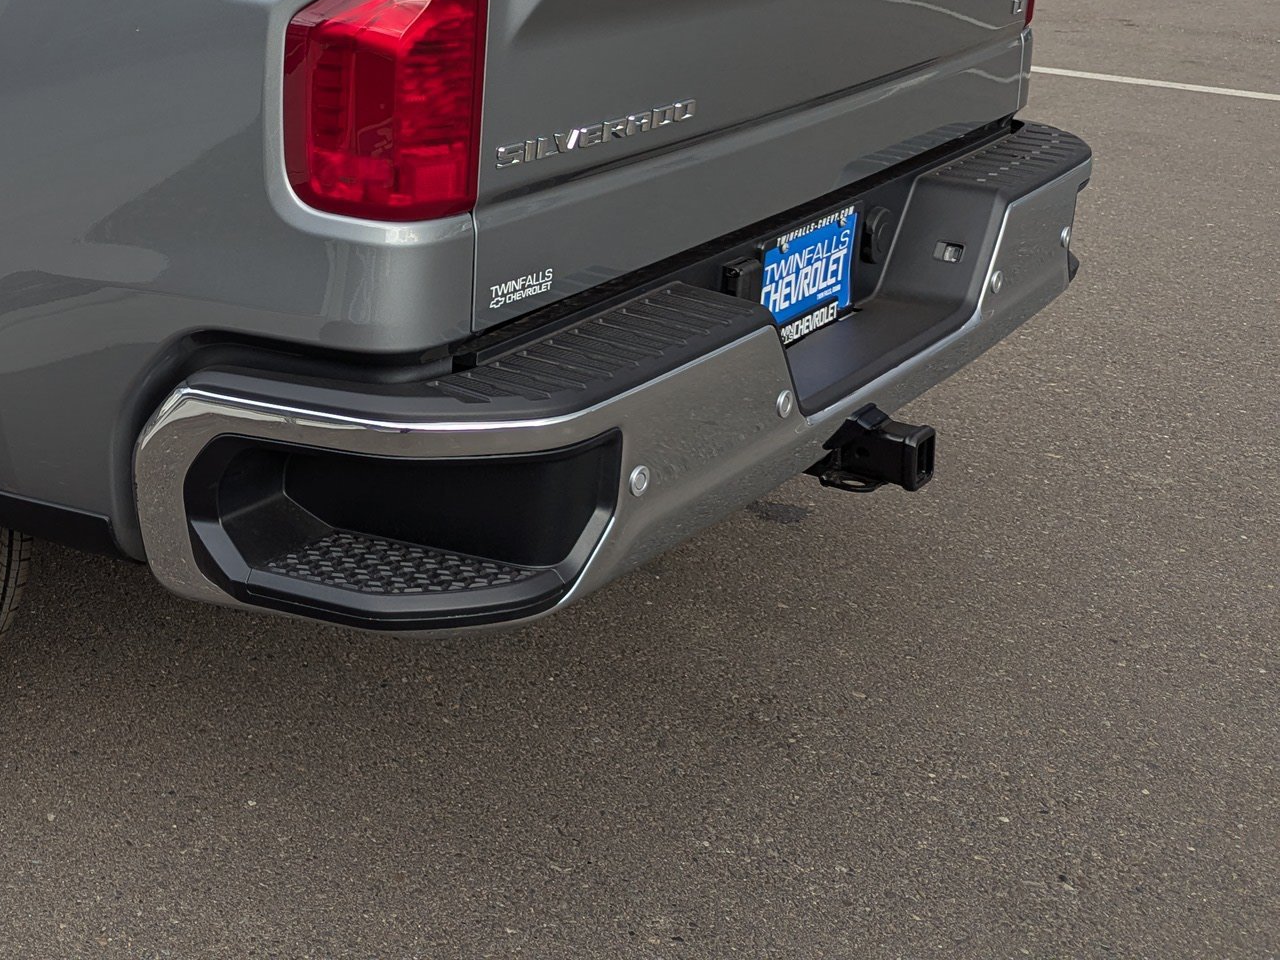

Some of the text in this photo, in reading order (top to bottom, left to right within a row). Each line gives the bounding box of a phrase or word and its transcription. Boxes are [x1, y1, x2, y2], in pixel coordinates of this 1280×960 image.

[496, 98, 696, 169] SILVERADO
[760, 247, 848, 313] CHEVROLET
[764, 229, 851, 286] TWINFALLS
[490, 268, 553, 298] TWINFALLS
[506, 280, 552, 304] CHEVROLET
[792, 301, 839, 339] CHEVROLET
